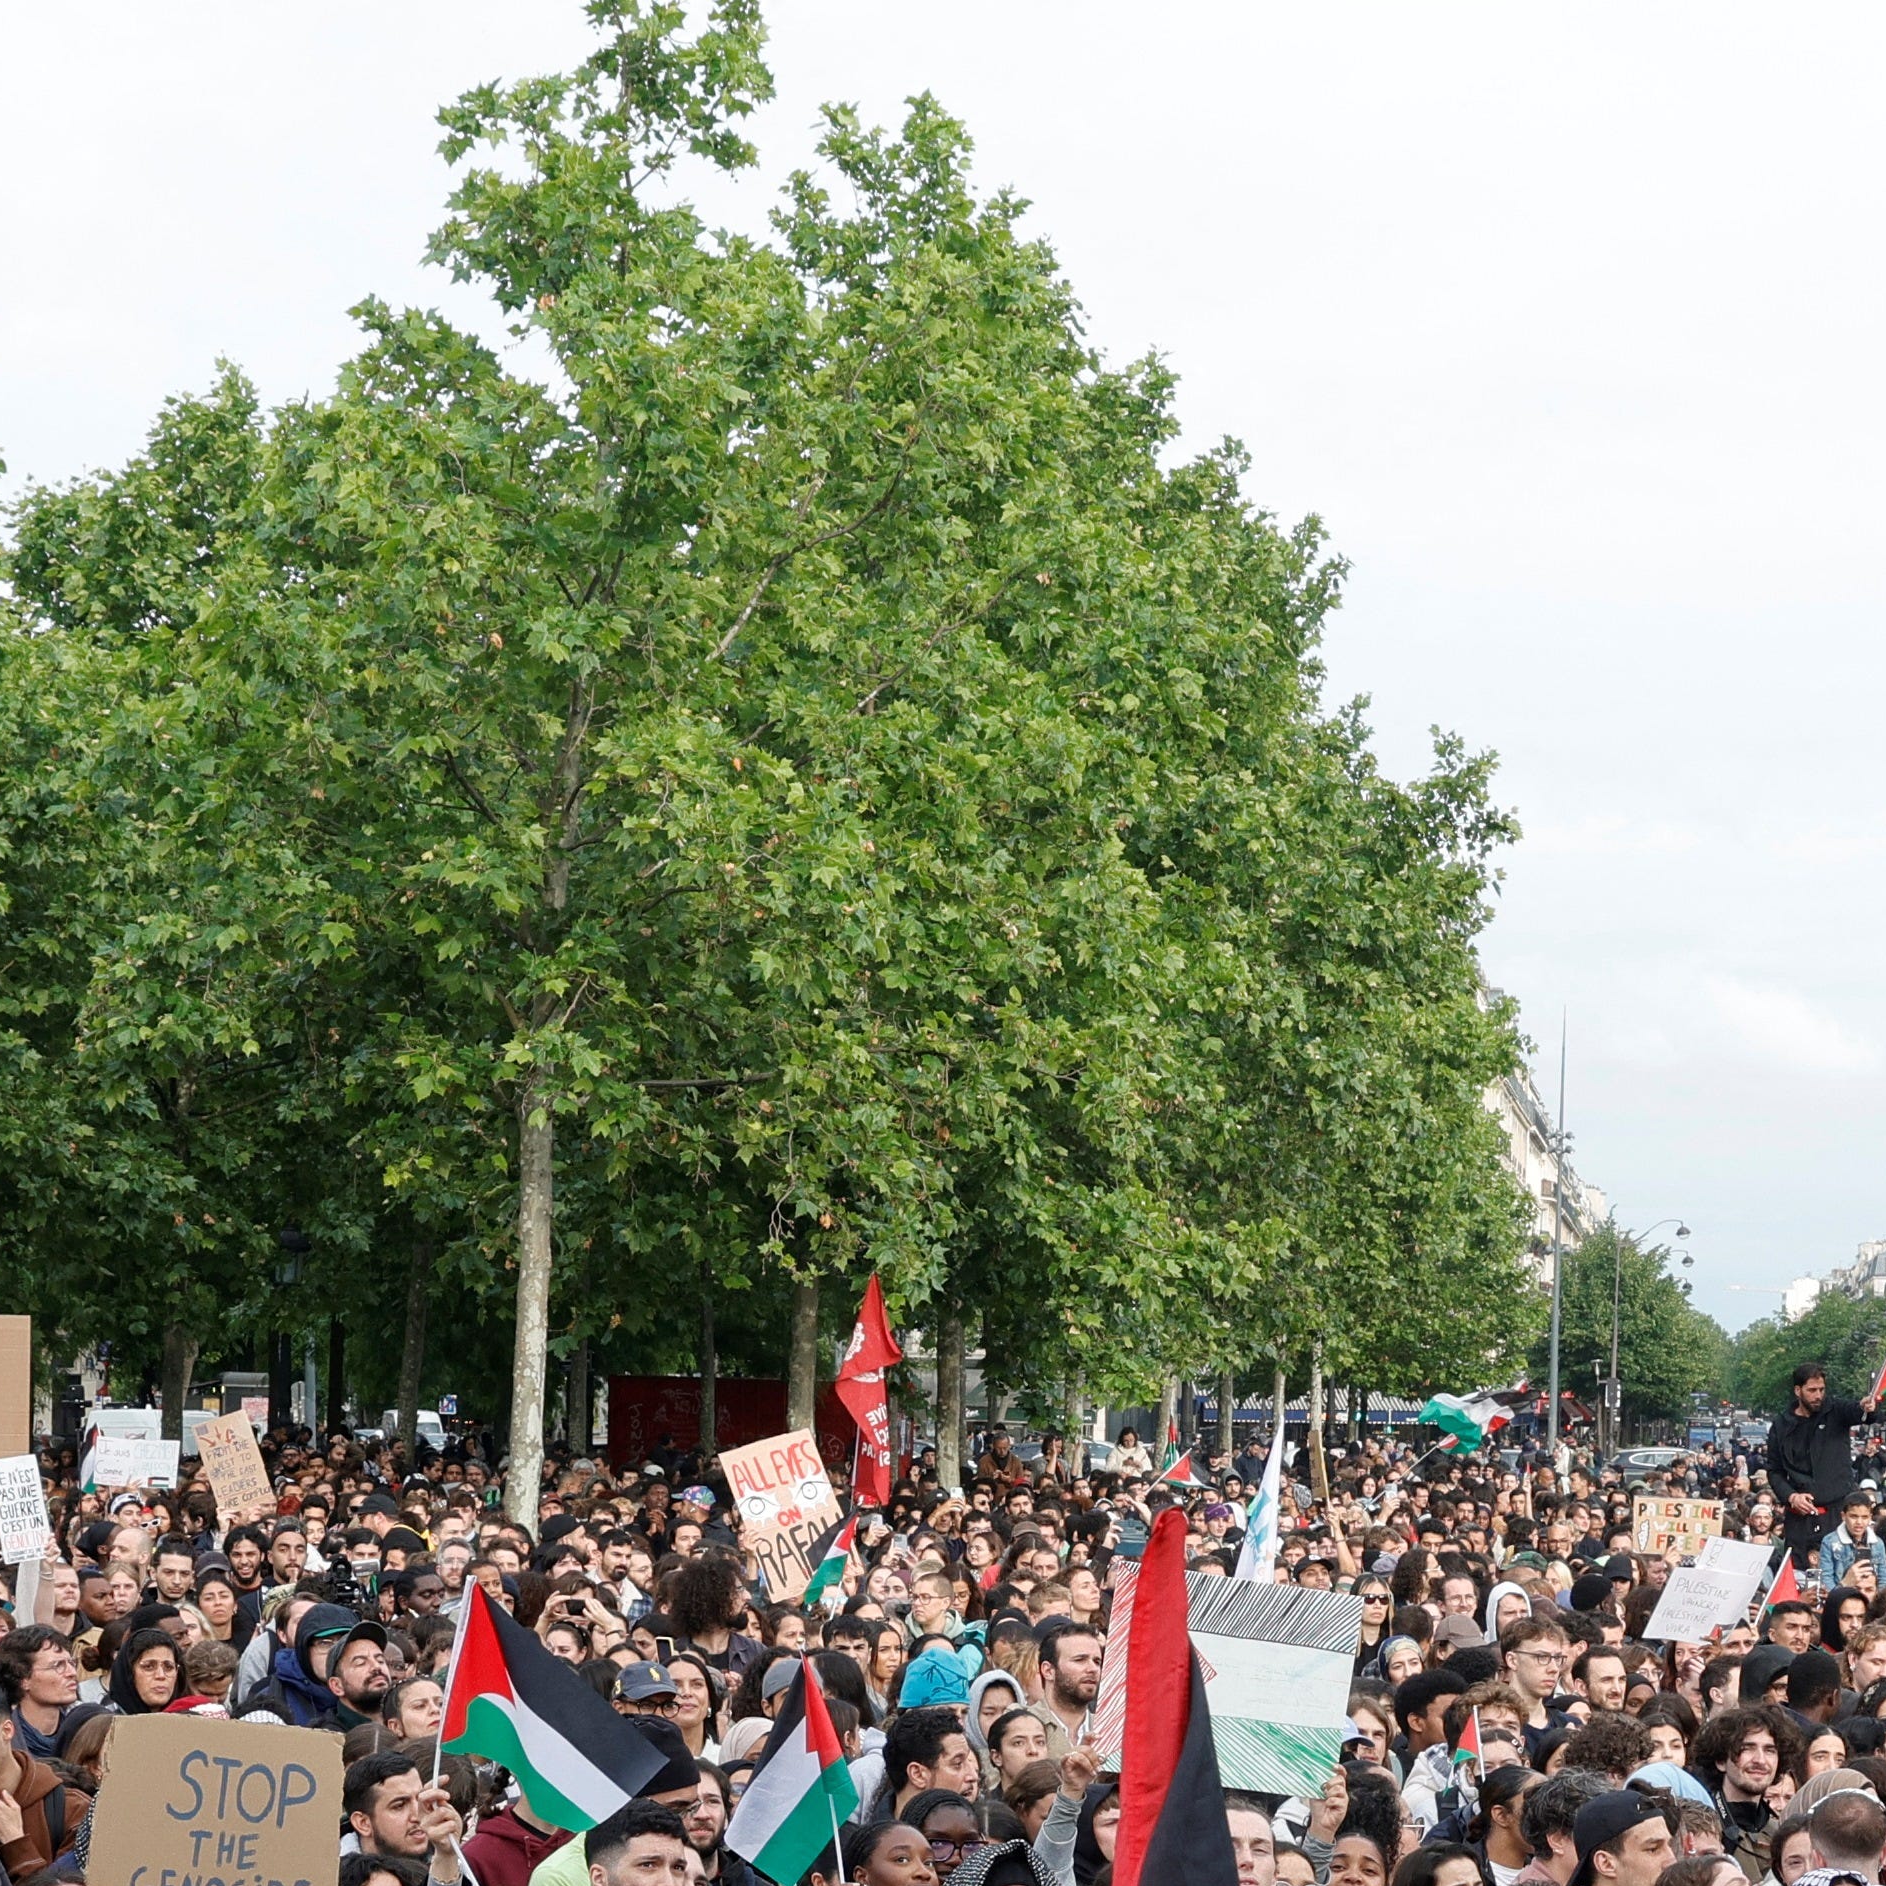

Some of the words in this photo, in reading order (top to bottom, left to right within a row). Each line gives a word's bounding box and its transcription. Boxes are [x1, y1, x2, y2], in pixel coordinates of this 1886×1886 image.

[239, 1452, 252, 1464] TO
[8, 1468, 36, 1486] N'EST
[238, 1463, 258, 1477] EAST
[731, 1456, 777, 1499] ALL
[769, 1439, 822, 1486] EYES
[17, 1483, 38, 1499] UNE
[216, 1476, 258, 1499] LEADERS
[776, 1504, 803, 1527] ON
[1637, 1502, 1721, 1521] PALESTINE
[0, 1518, 28, 1535] C'EST
[29, 1514, 45, 1529] UN
[1653, 1520, 1689, 1534] WILL
[1694, 1521, 1709, 1534] BE
[1655, 1534, 1694, 1551] FREE
[1674, 1576, 1732, 1600] PALESTINE
[1681, 1599, 1721, 1612] VAINCRA
[1661, 1607, 1709, 1624] PALESTINE
[165, 1749, 317, 1829] STOP
[189, 1829, 260, 1870] THE
